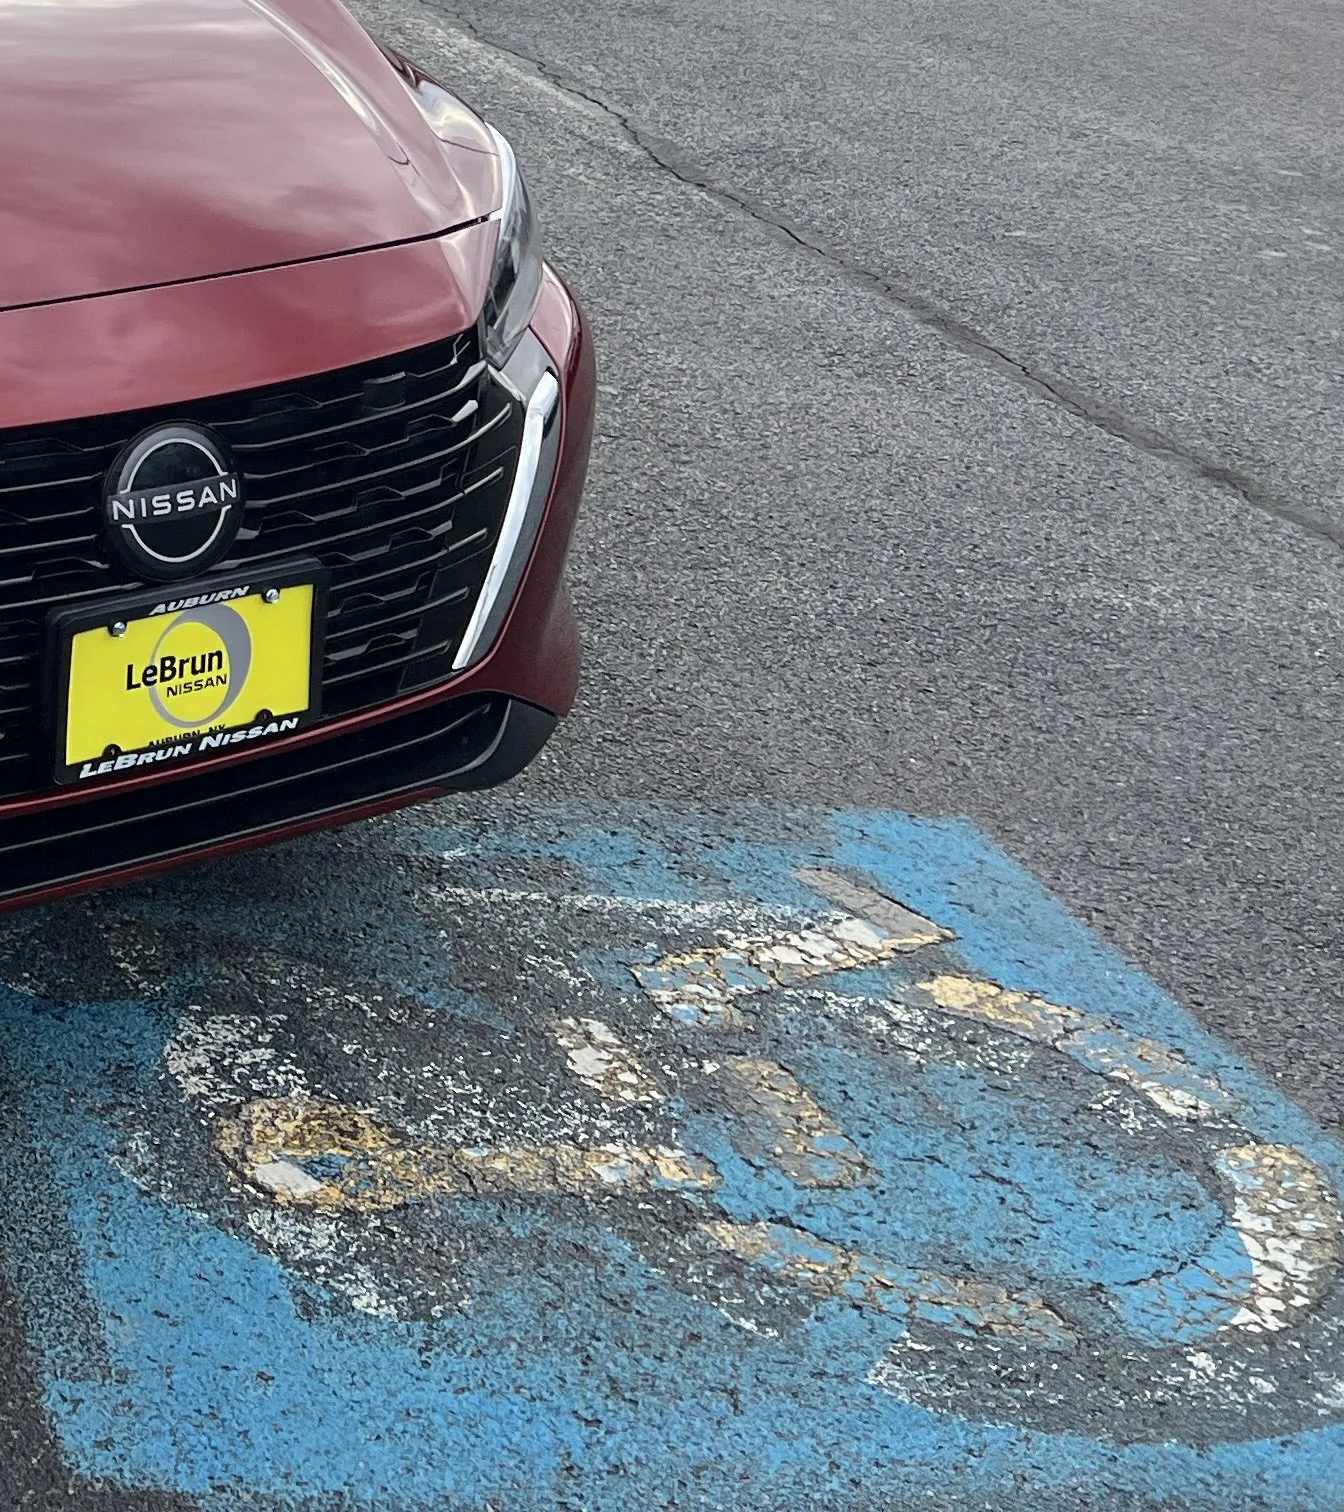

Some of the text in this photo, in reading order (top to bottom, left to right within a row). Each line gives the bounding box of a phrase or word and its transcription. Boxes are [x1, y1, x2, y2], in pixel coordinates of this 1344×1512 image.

[112, 478, 237, 522] NISSAN
[148, 585, 251, 617] AUBURN
[125, 649, 224, 691] LeBrun
[165, 674, 228, 699] NISSAN
